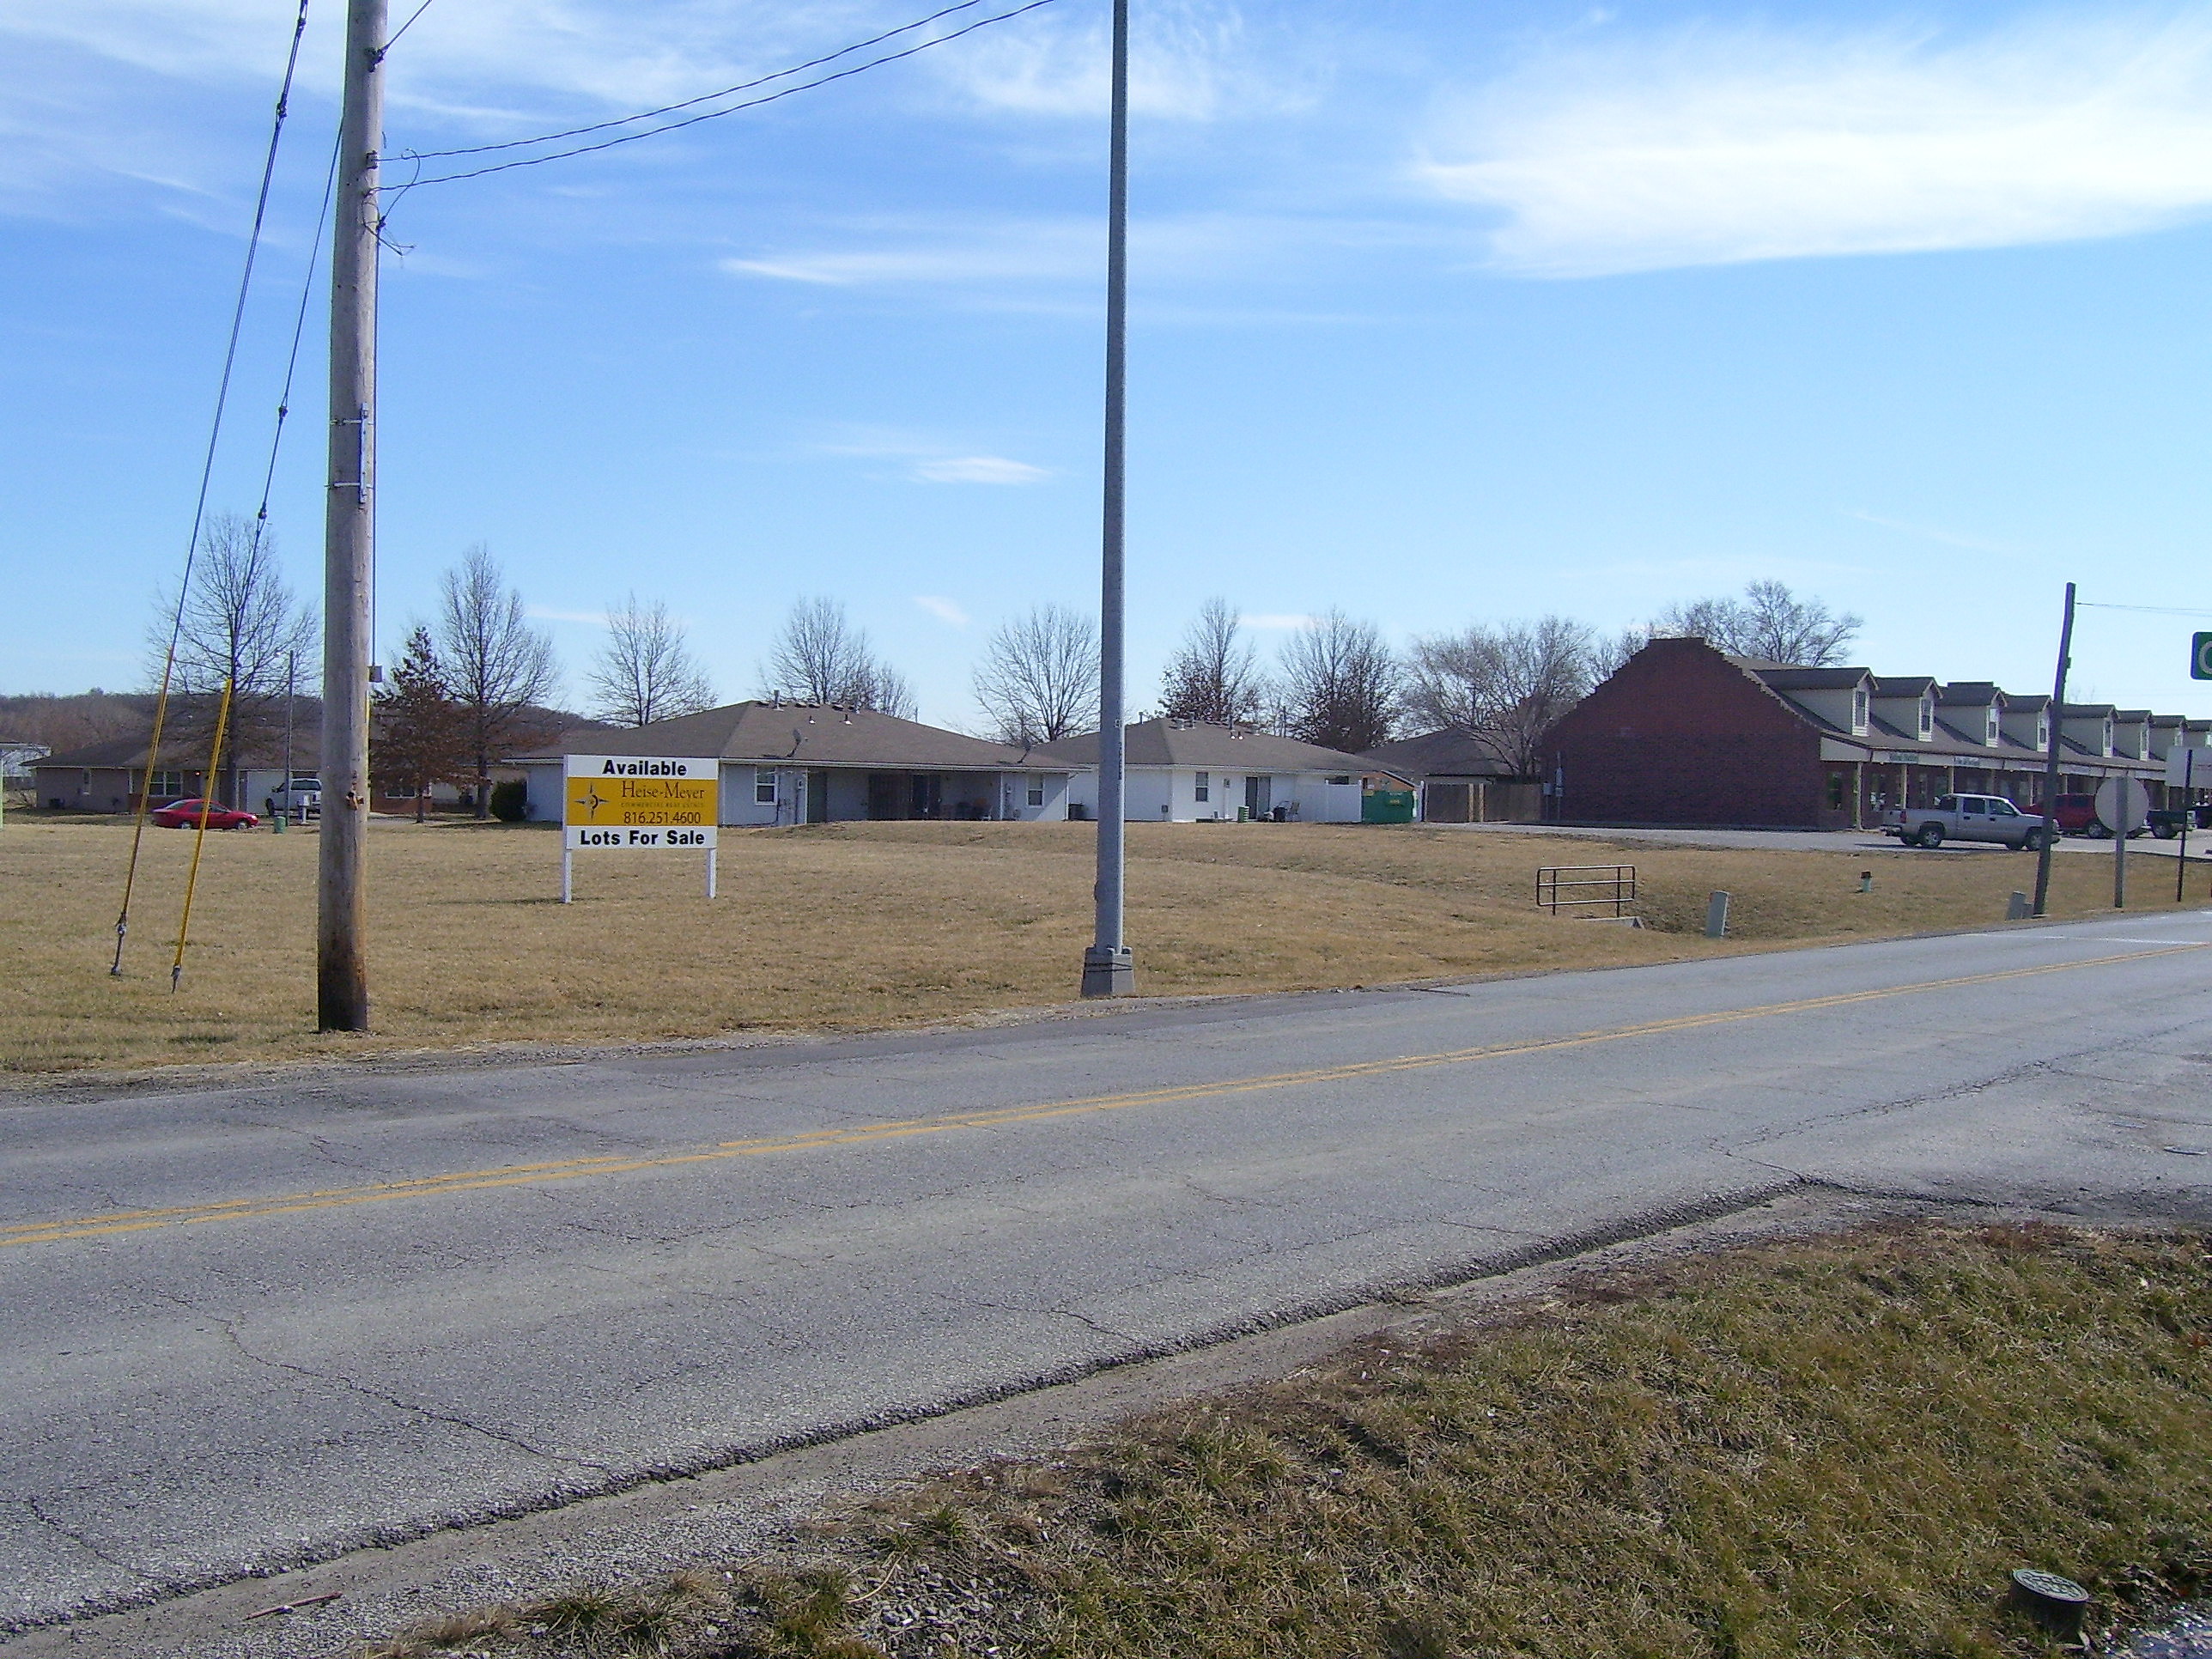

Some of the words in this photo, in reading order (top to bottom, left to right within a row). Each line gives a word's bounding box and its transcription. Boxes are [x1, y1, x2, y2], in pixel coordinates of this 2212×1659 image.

[602, 759, 687, 775] Available
[622, 781, 705, 799] Heise-Meyer
[623, 811, 702, 824] 816.251.4600
[580, 830, 621, 845] Lots
[629, 830, 659, 845] For
[666, 830, 705, 845] Sale
